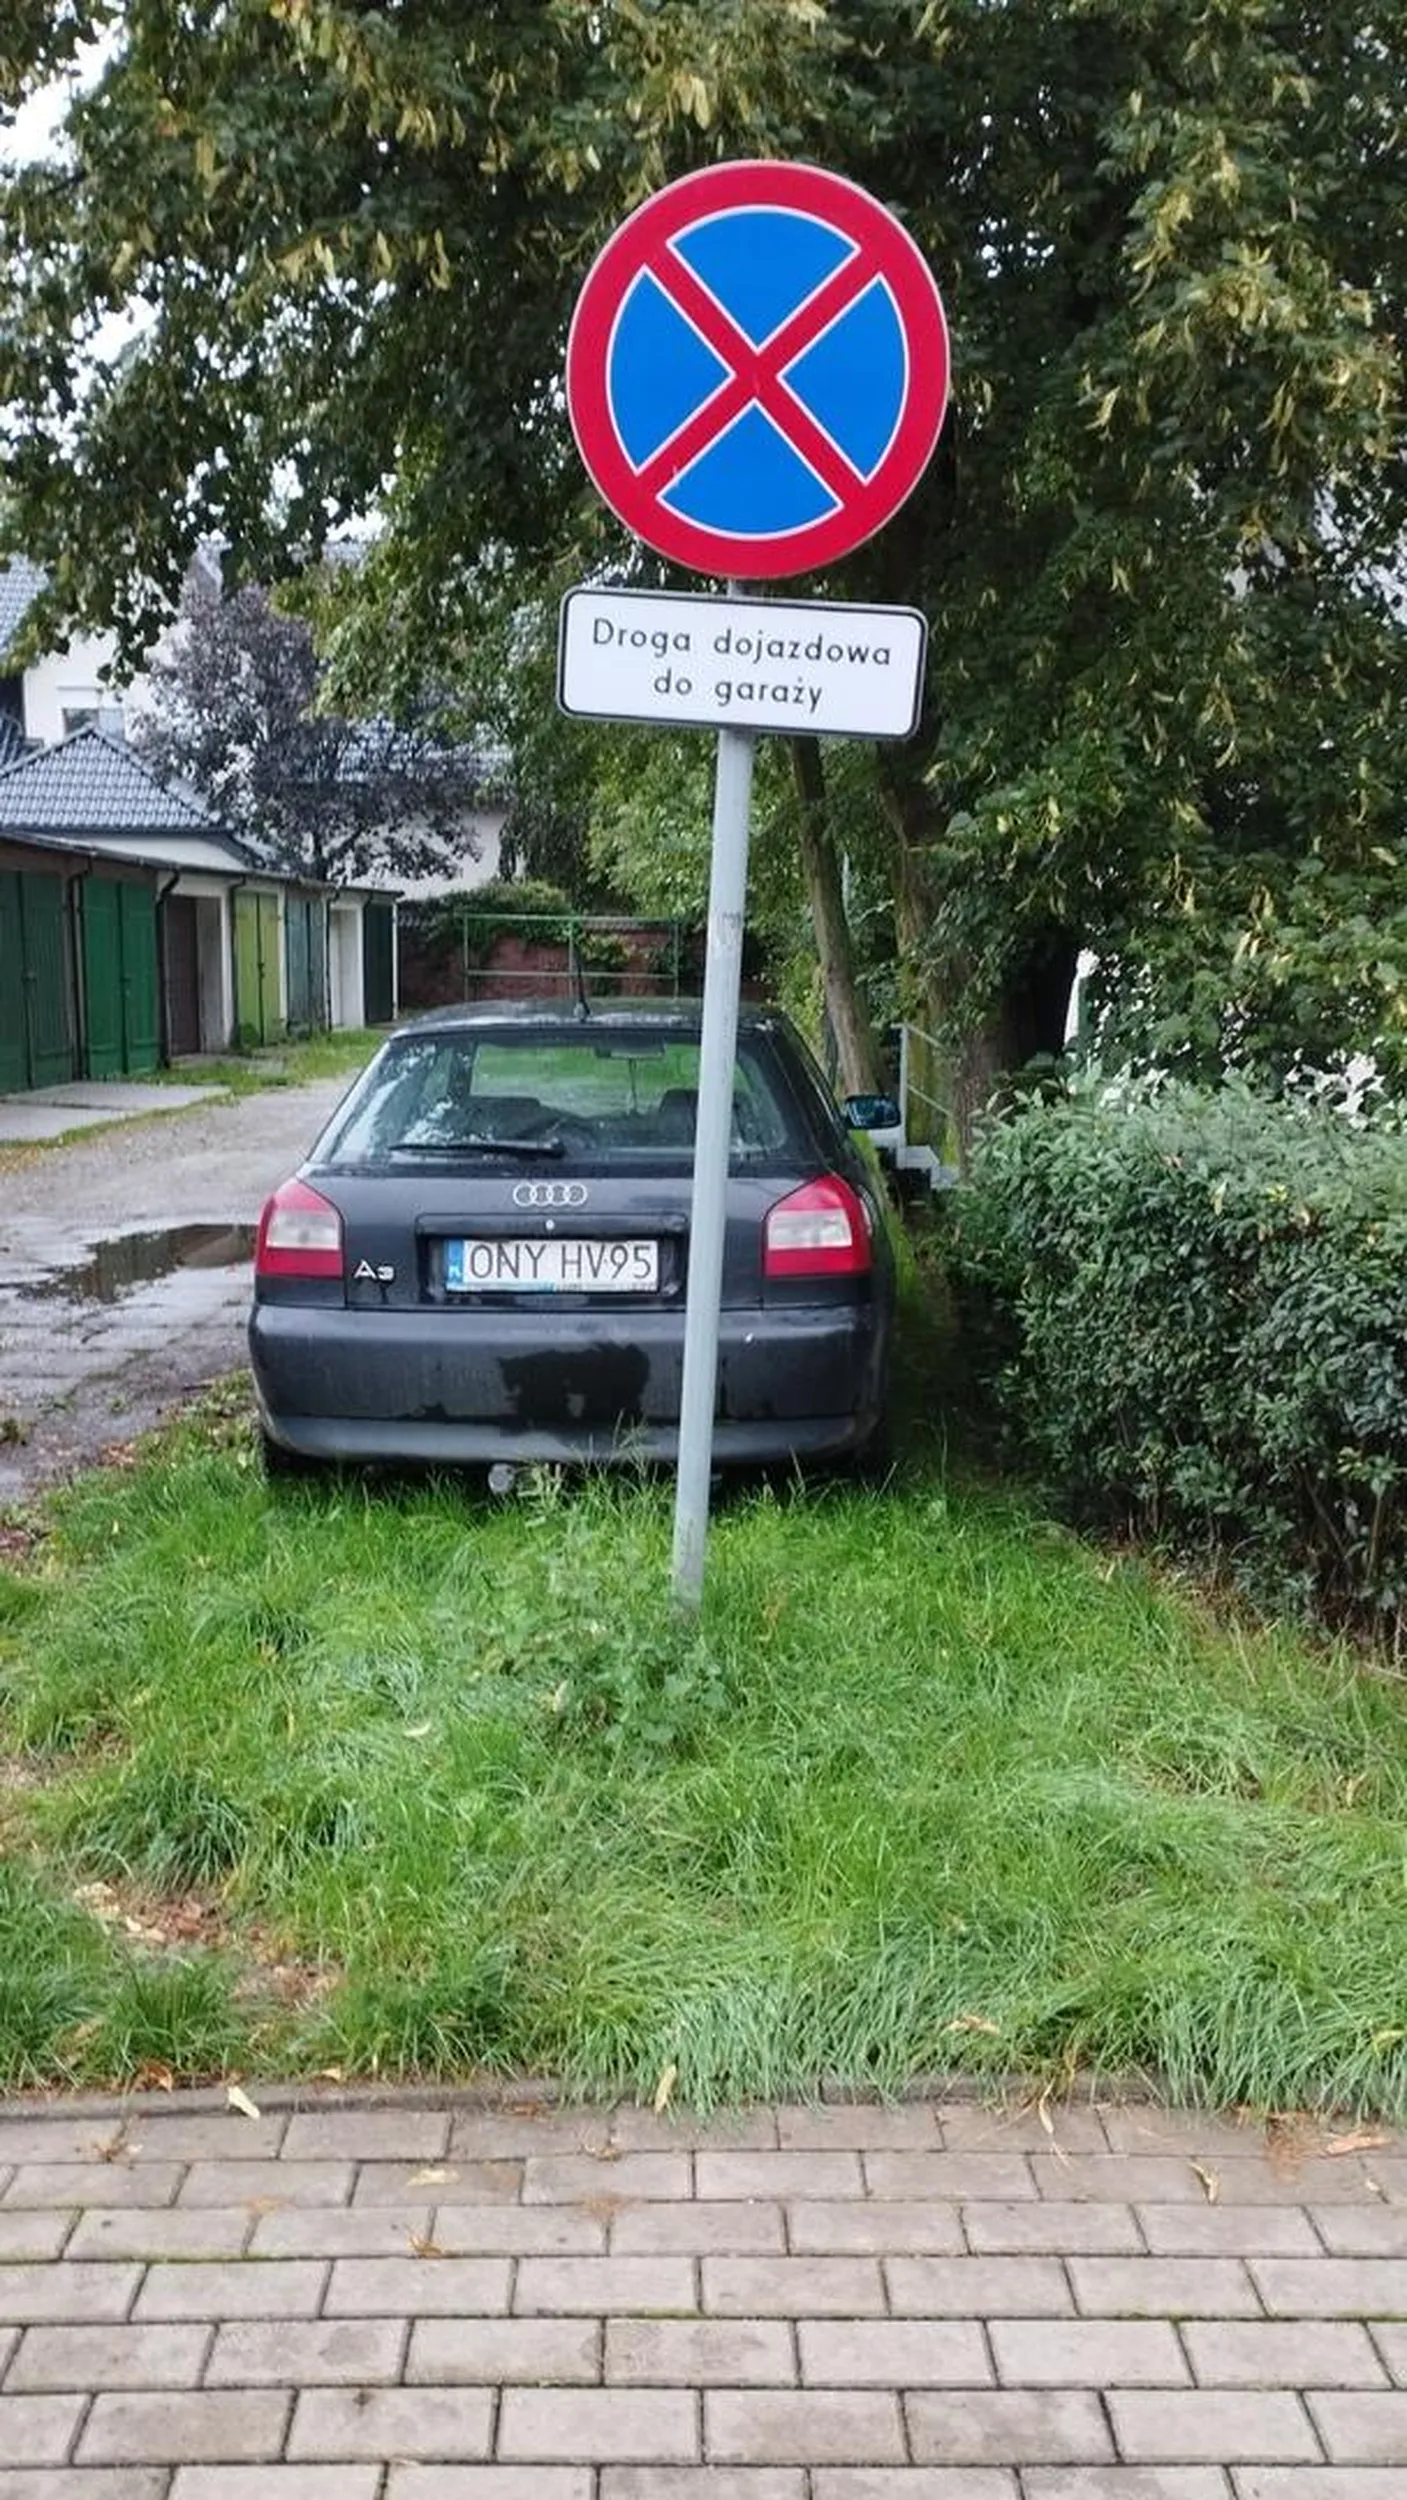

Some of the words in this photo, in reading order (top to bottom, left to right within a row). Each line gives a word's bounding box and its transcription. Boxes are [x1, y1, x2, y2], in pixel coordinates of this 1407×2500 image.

[592, 617, 691, 658] Droga
[713, 627, 892, 666] dojazdowa
[653, 668, 693, 696] do
[714, 676, 823, 713] garaży
[353, 1259, 394, 1281] A3
[470, 1243, 548, 1279] ONY
[561, 1243, 652, 1279] HV95
